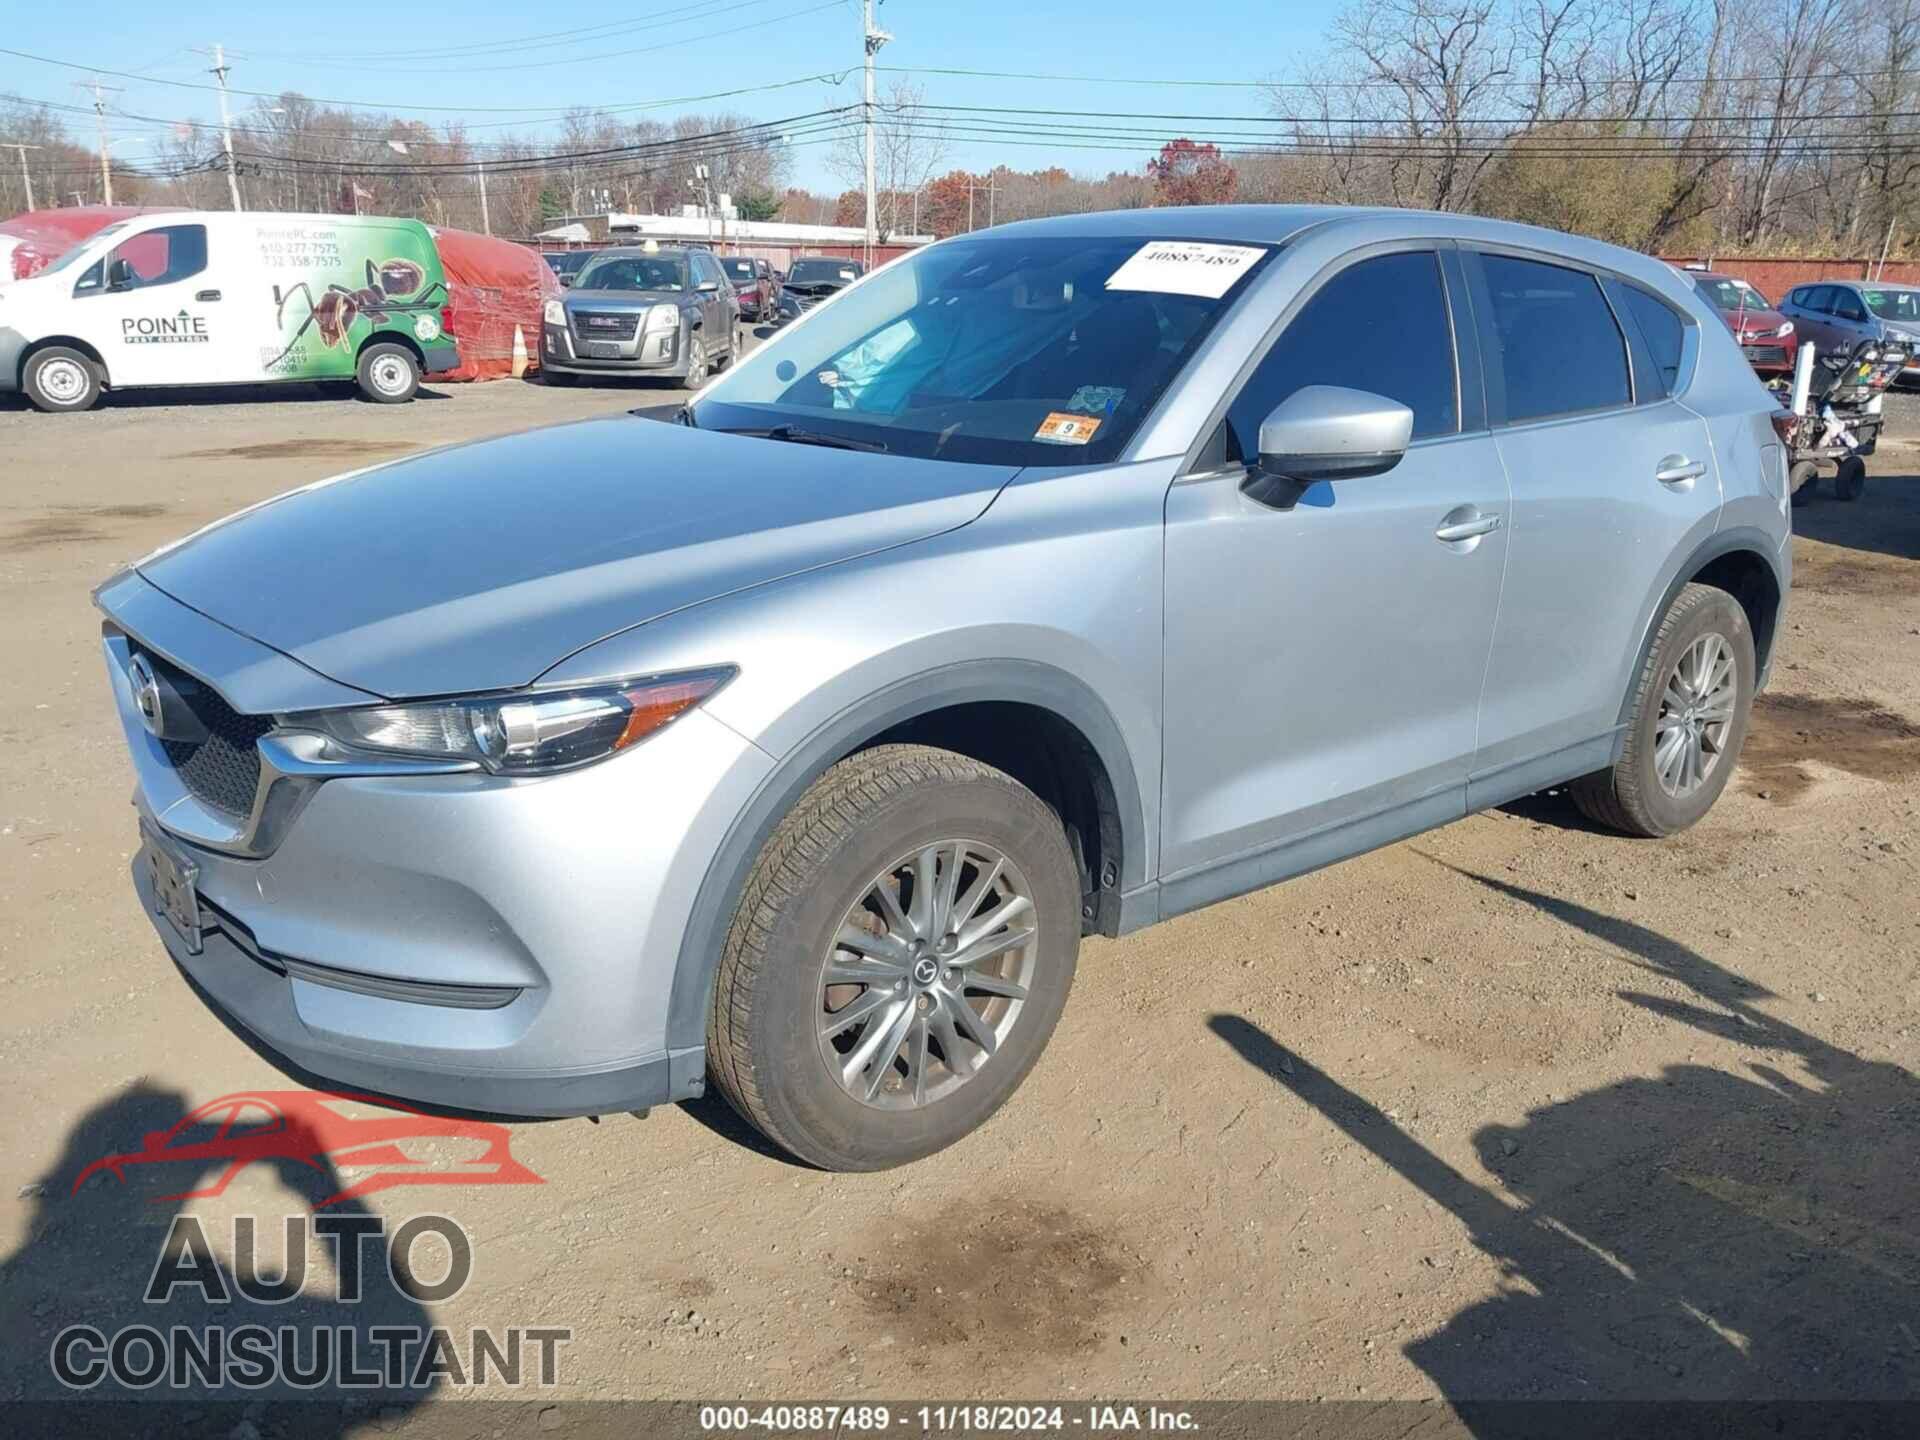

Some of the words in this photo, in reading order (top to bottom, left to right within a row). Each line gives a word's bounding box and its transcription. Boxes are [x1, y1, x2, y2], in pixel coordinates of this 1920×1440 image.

[1145, 251, 1240, 266] 40887489
[122, 316, 208, 335] POINTE
[1063, 423, 1074, 434] 9
